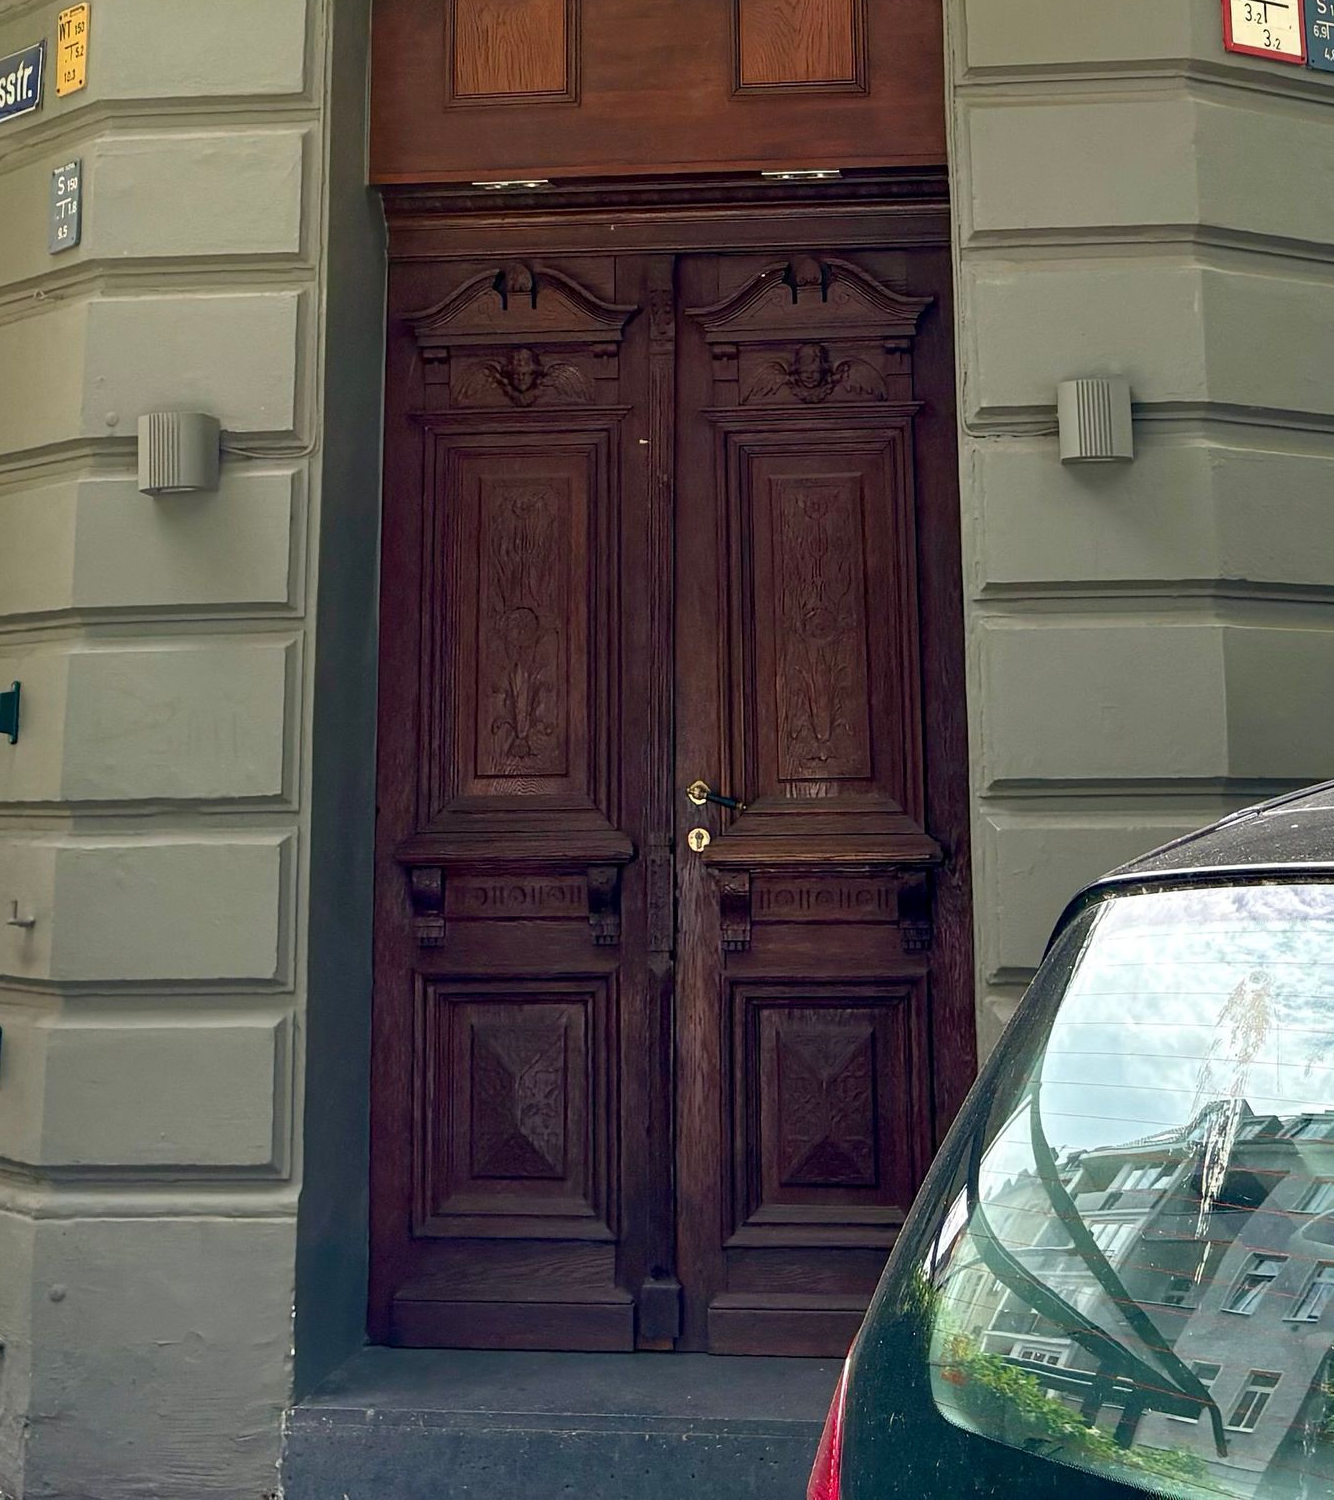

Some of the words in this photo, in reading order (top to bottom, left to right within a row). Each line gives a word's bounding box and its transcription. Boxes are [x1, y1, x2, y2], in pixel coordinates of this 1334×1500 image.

[1244, 3, 1263, 25] 3.2
[1263, 29, 1281, 50] 3.2
[57, 176, 65, 195] S
